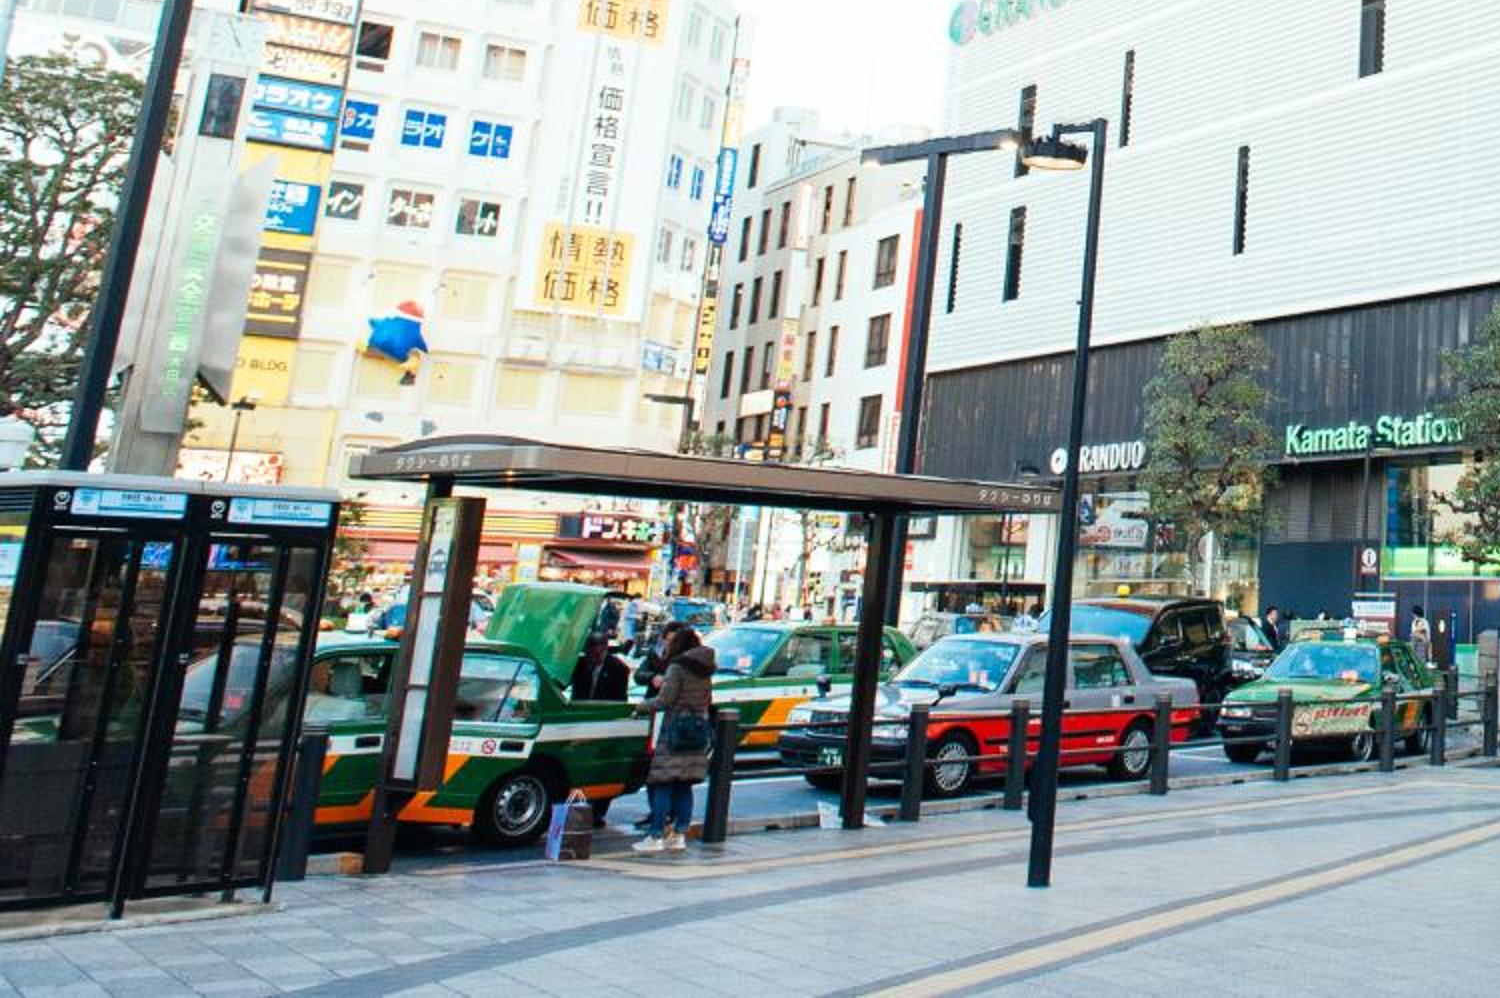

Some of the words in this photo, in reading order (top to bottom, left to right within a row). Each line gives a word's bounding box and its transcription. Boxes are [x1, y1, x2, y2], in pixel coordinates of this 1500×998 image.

[1285, 421, 1373, 454] Kamata
[1375, 412, 1466, 447] Station
[1076, 440, 1147, 472] RANDUO
[978, 489, 1053, 505] タクシーのりば
